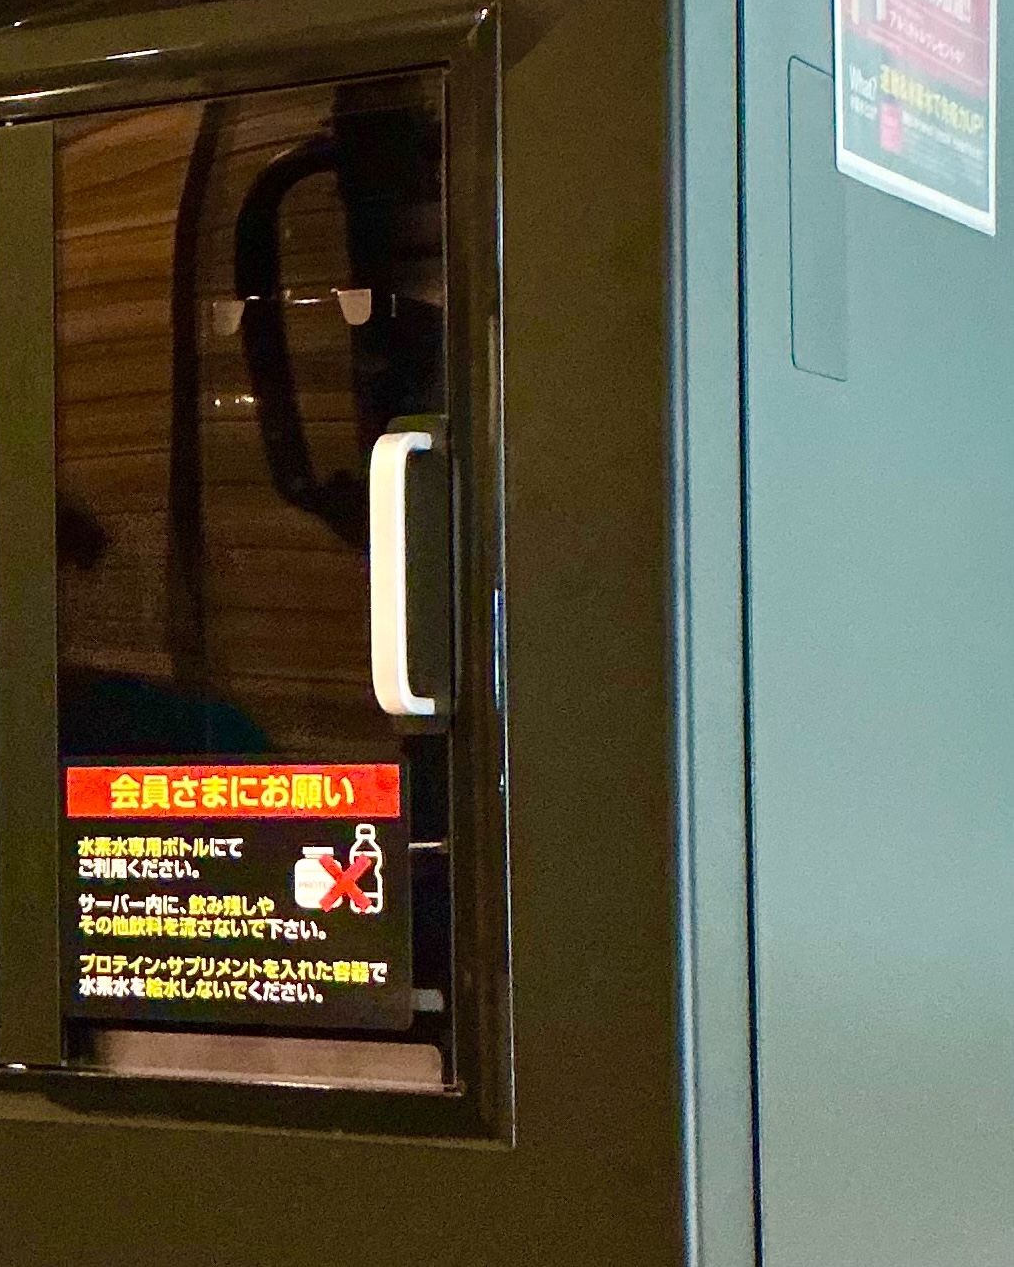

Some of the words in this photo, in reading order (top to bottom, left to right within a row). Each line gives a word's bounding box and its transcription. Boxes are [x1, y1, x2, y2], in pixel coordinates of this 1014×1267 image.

[109, 772, 355, 810] 会員さまにお願い
[77, 836, 244, 859] 水素水専用ボトルにて
[77, 857, 201, 880] ご利用ください。
[78, 894, 275, 917] サーバー内に、飲み残しや
[78, 918, 328, 941] その他飲料を流さないで下さい。
[79, 954, 388, 984] プロテイン・サプリメントを入れた容器で
[78, 976, 324, 1004] 水素水を給水しないでください。
